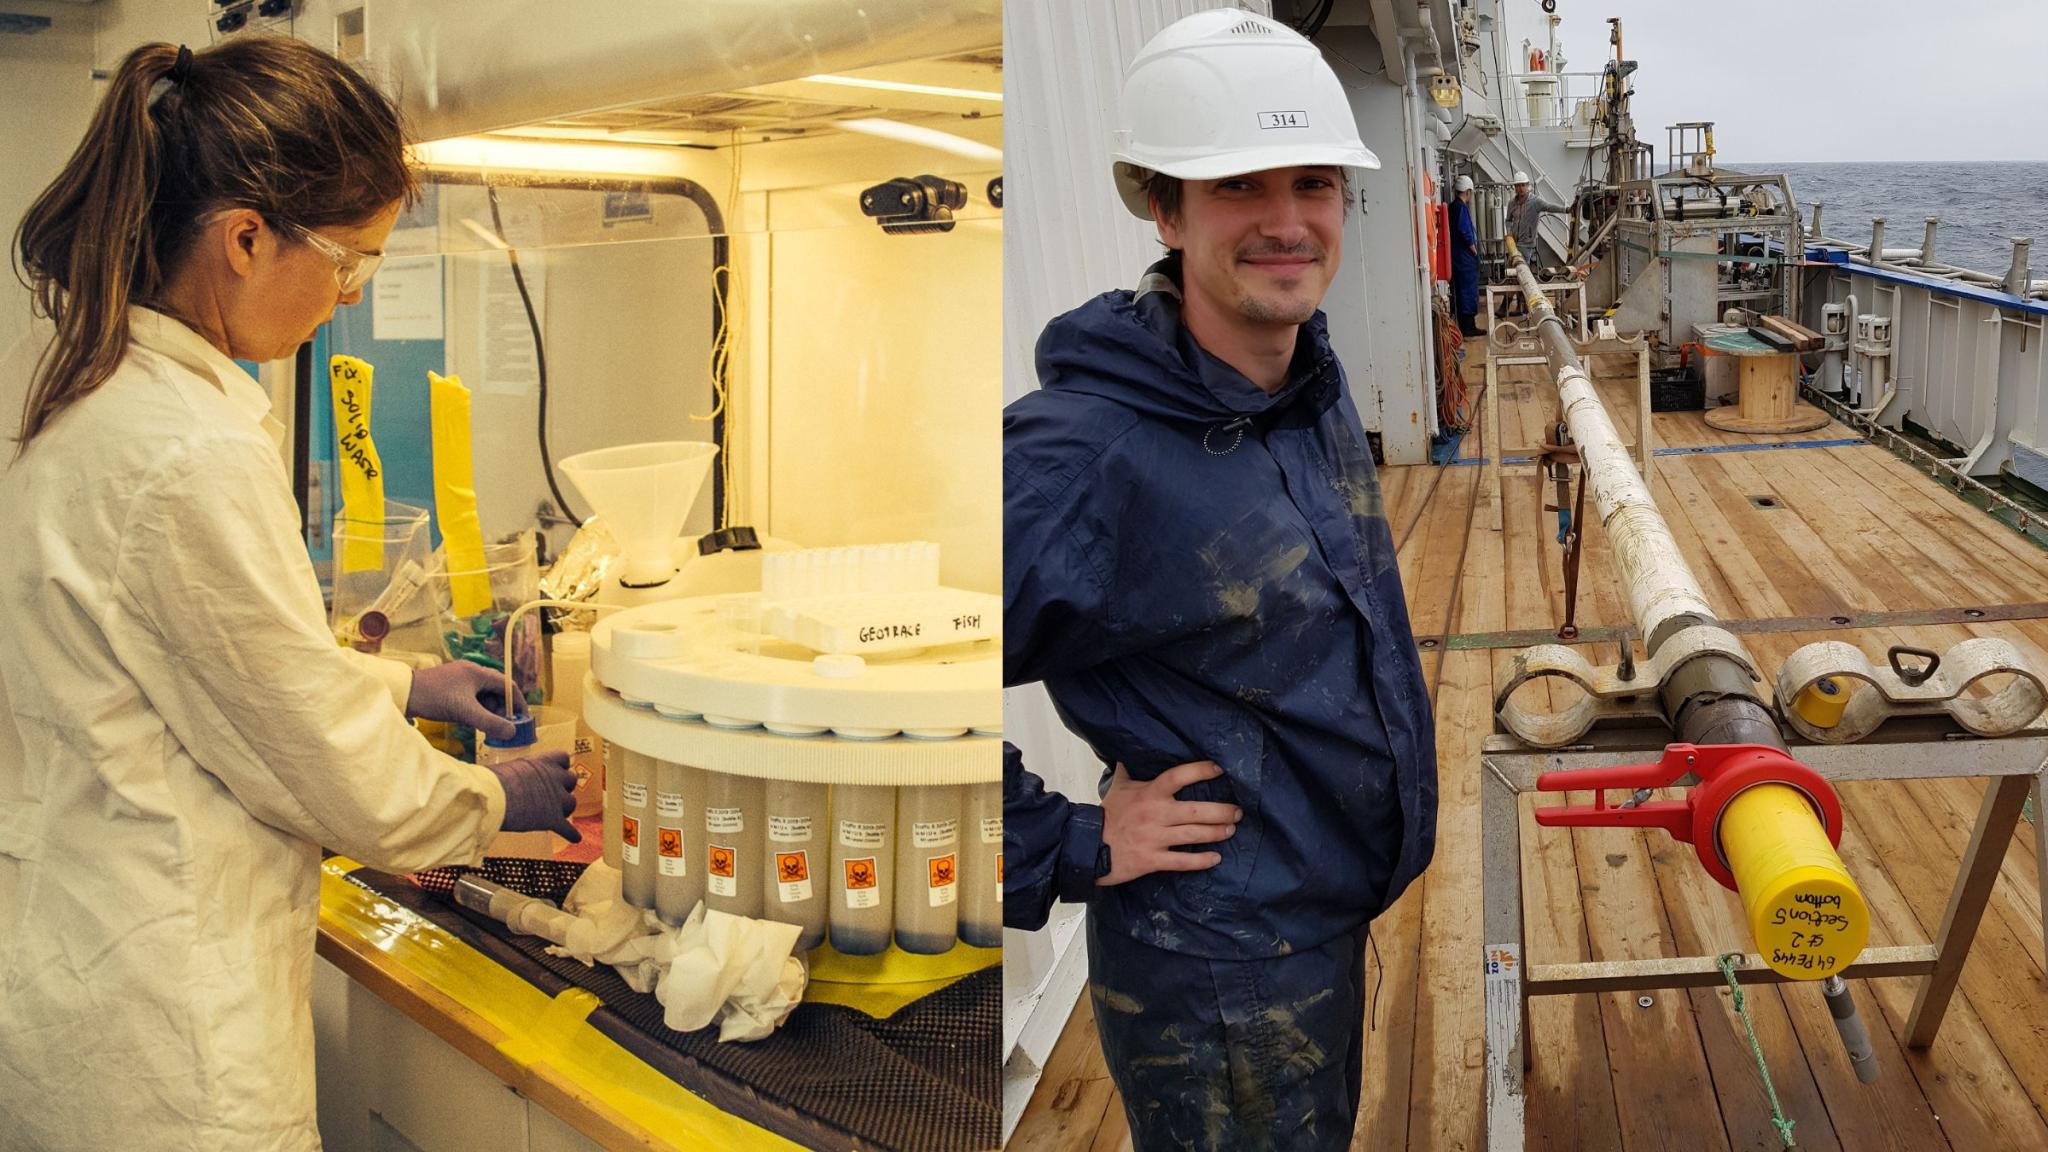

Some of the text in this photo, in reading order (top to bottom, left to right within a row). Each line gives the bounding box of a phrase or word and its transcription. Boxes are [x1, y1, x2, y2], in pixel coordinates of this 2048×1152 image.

[1271, 113, 1297, 127] 314
[859, 623, 921, 643] GEOTRACE
[1795, 893, 1841, 910] bottom
[1771, 907, 1849, 932] Section 5
[1791, 931, 1805, 948] 2
